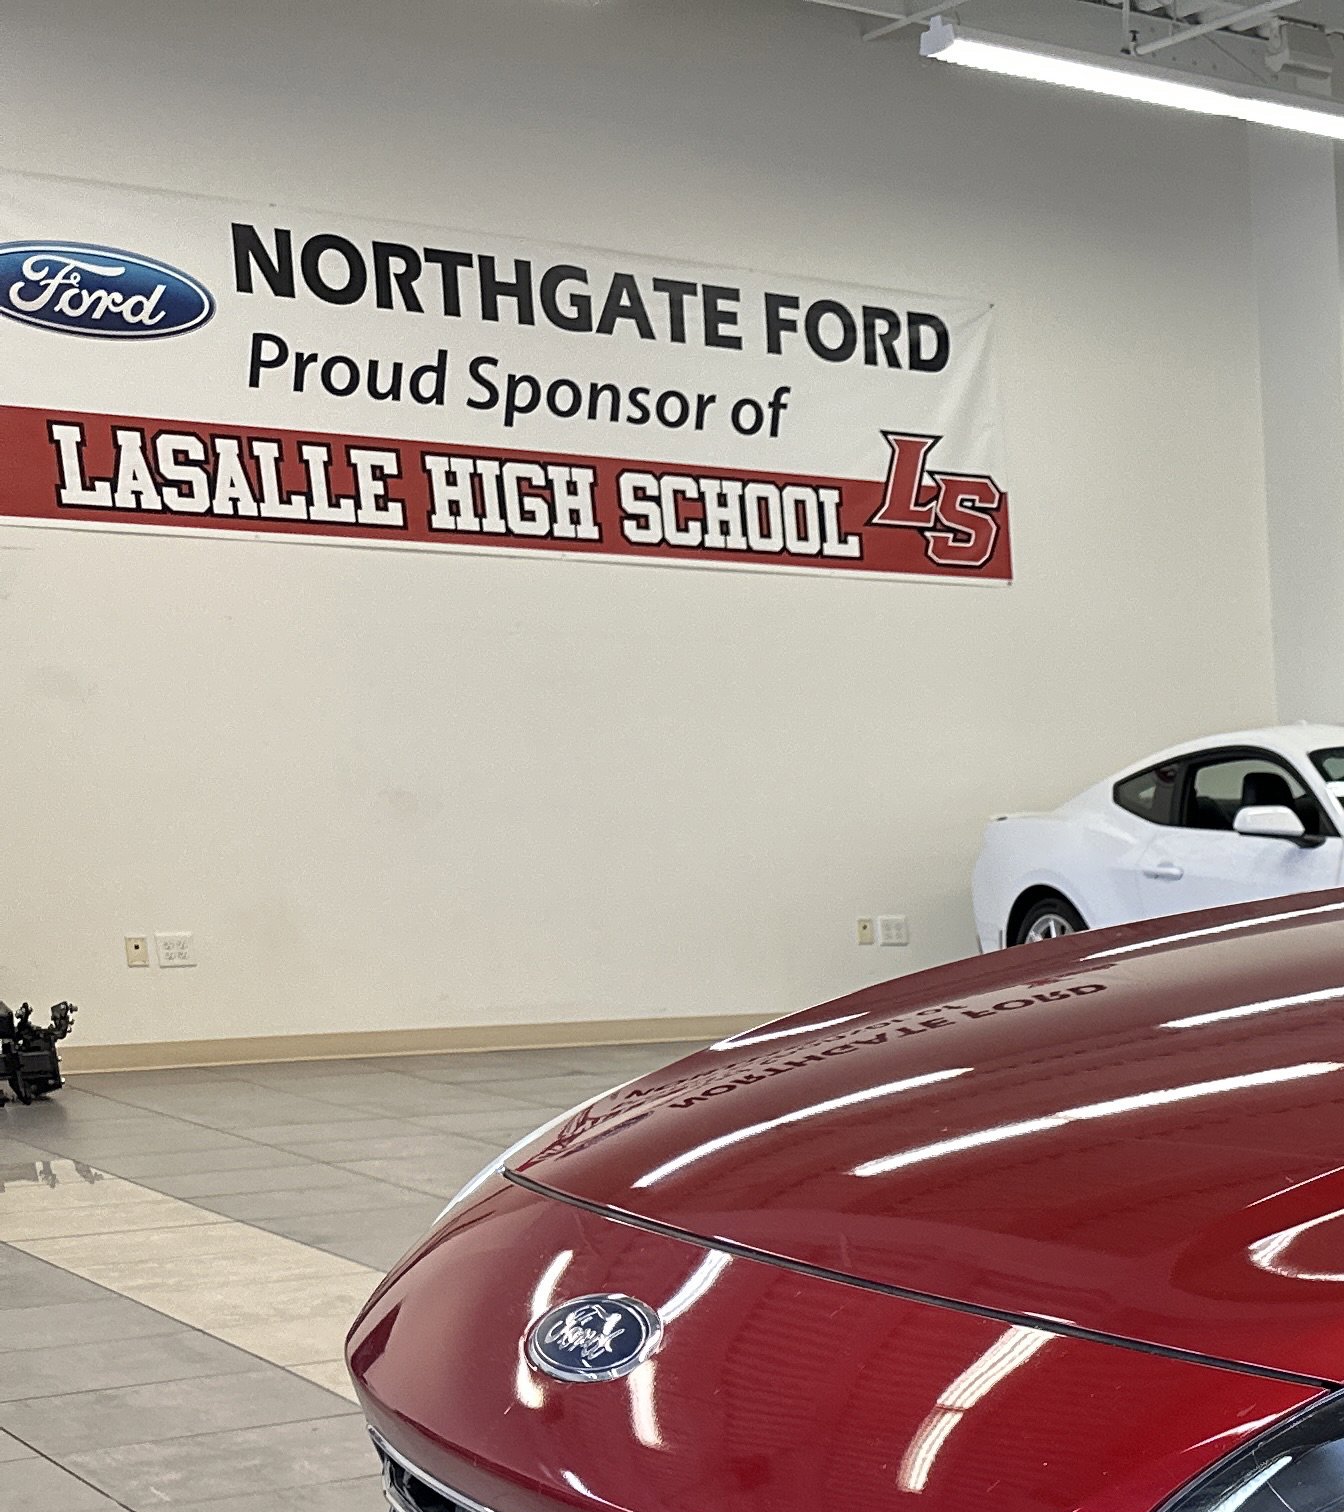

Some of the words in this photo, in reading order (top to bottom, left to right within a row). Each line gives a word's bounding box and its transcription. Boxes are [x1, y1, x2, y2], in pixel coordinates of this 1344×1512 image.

[8, 253, 168, 326] Ford
[230, 222, 742, 351] NORTHGATE
[763, 291, 950, 373] FORD
[248, 332, 449, 405] Proud
[465, 355, 717, 428] Sponsor
[730, 386, 791, 438] of
[47, 418, 407, 530] LASALLE
[421, 450, 603, 544] HIGH
[616, 468, 864, 561] SCHOOL
[864, 429, 1005, 569] LS
